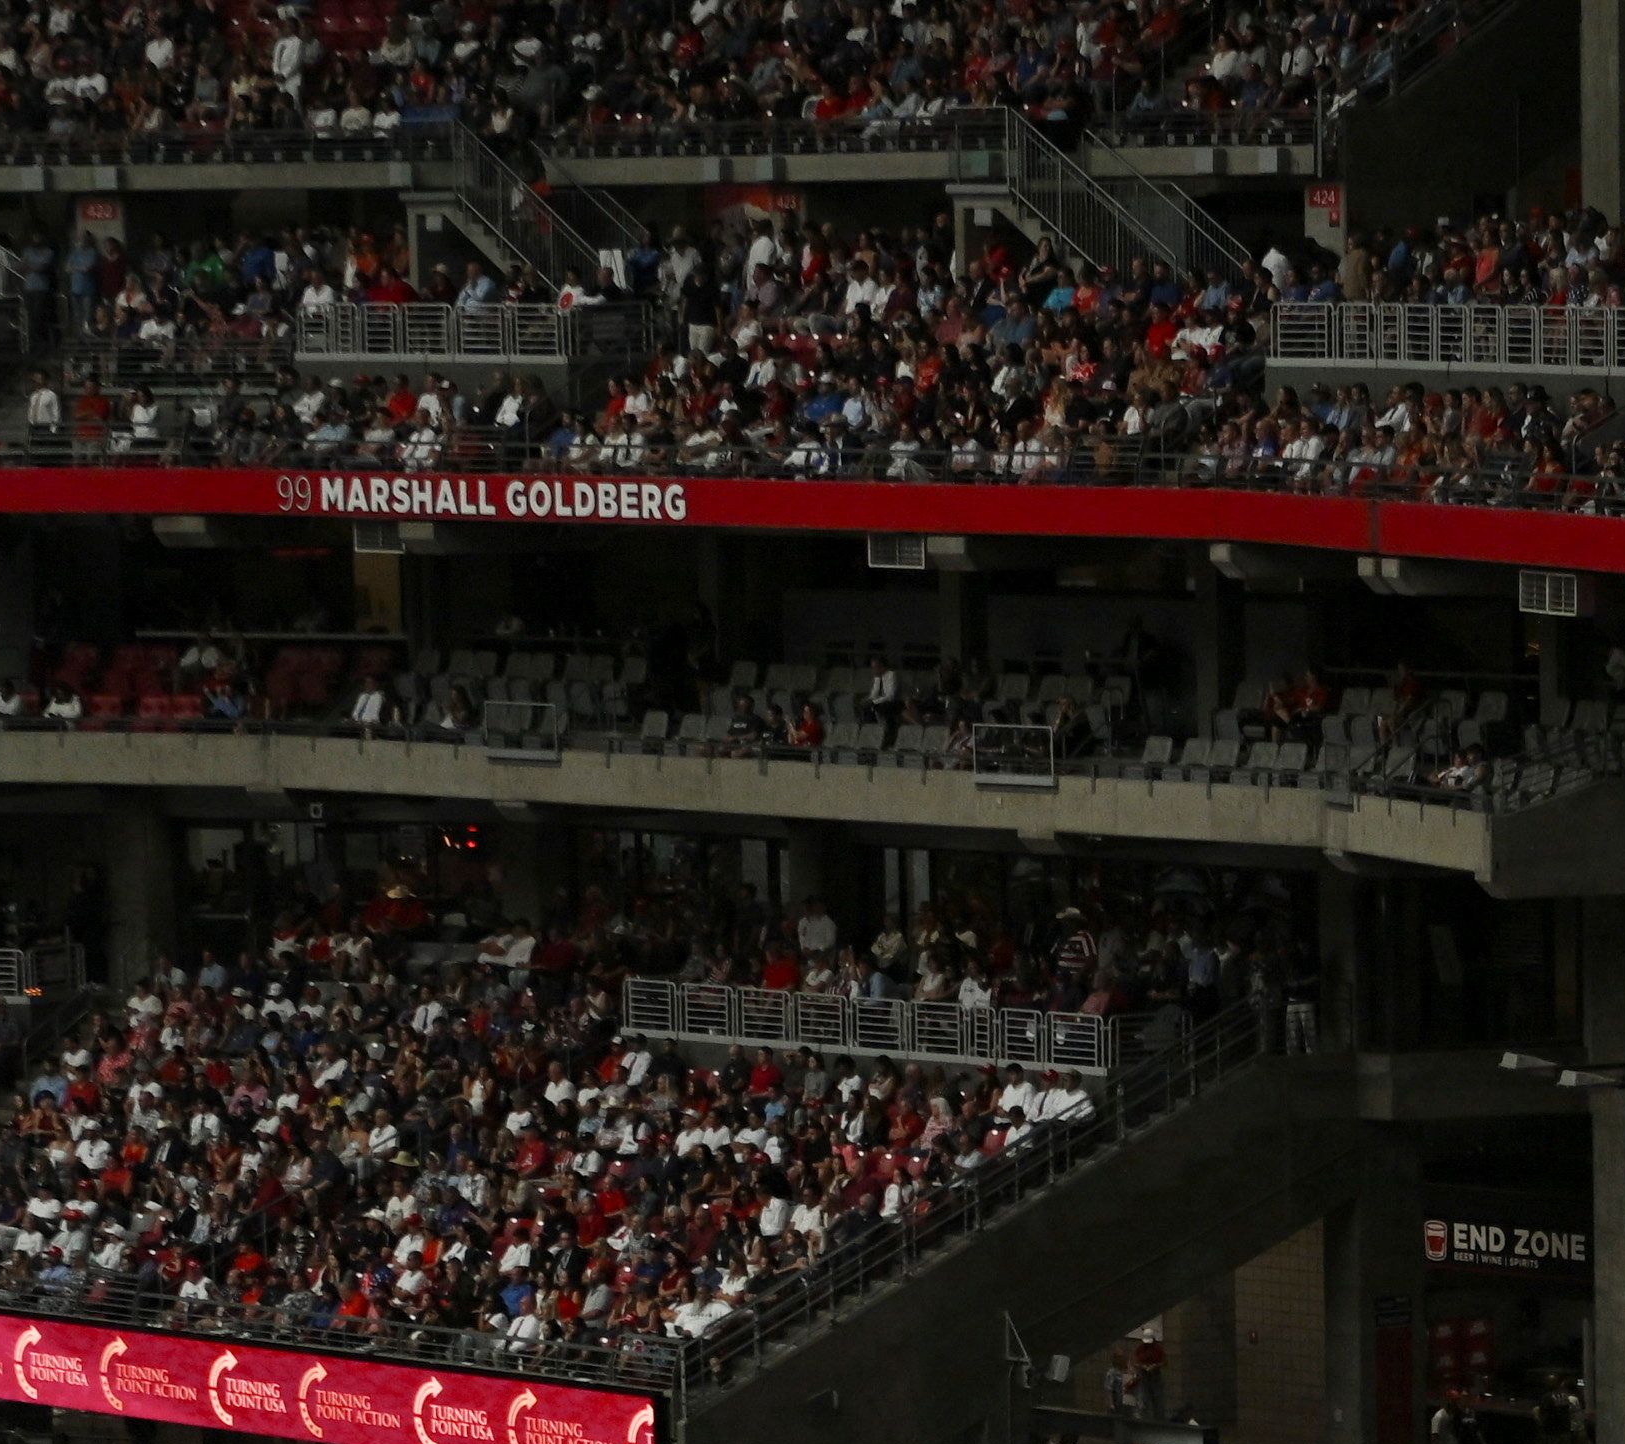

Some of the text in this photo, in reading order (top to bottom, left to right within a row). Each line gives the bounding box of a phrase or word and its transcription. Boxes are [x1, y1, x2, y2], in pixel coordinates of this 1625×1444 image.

[1313, 190, 1335, 205] 424
[277, 475, 687, 521] 99 MARSHALL GOLDBERG
[1453, 1222, 1586, 1262] END ZONE
[29, 1351, 83, 1371] TURNING
[30, 1365, 89, 1387] POINT USA
[116, 1363, 169, 1383] TURNING
[116, 1378, 197, 1401] POINT ACTION
[224, 1377, 280, 1398] TURNING
[225, 1392, 287, 1414] POINT USA
[315, 1389, 371, 1410] TURNING
[316, 1404, 401, 1428] POINT ACTION
[430, 1404, 488, 1425] TURNING
[431, 1420, 494, 1442] POINT USA
[524, 1416, 583, 1438] TURNING
